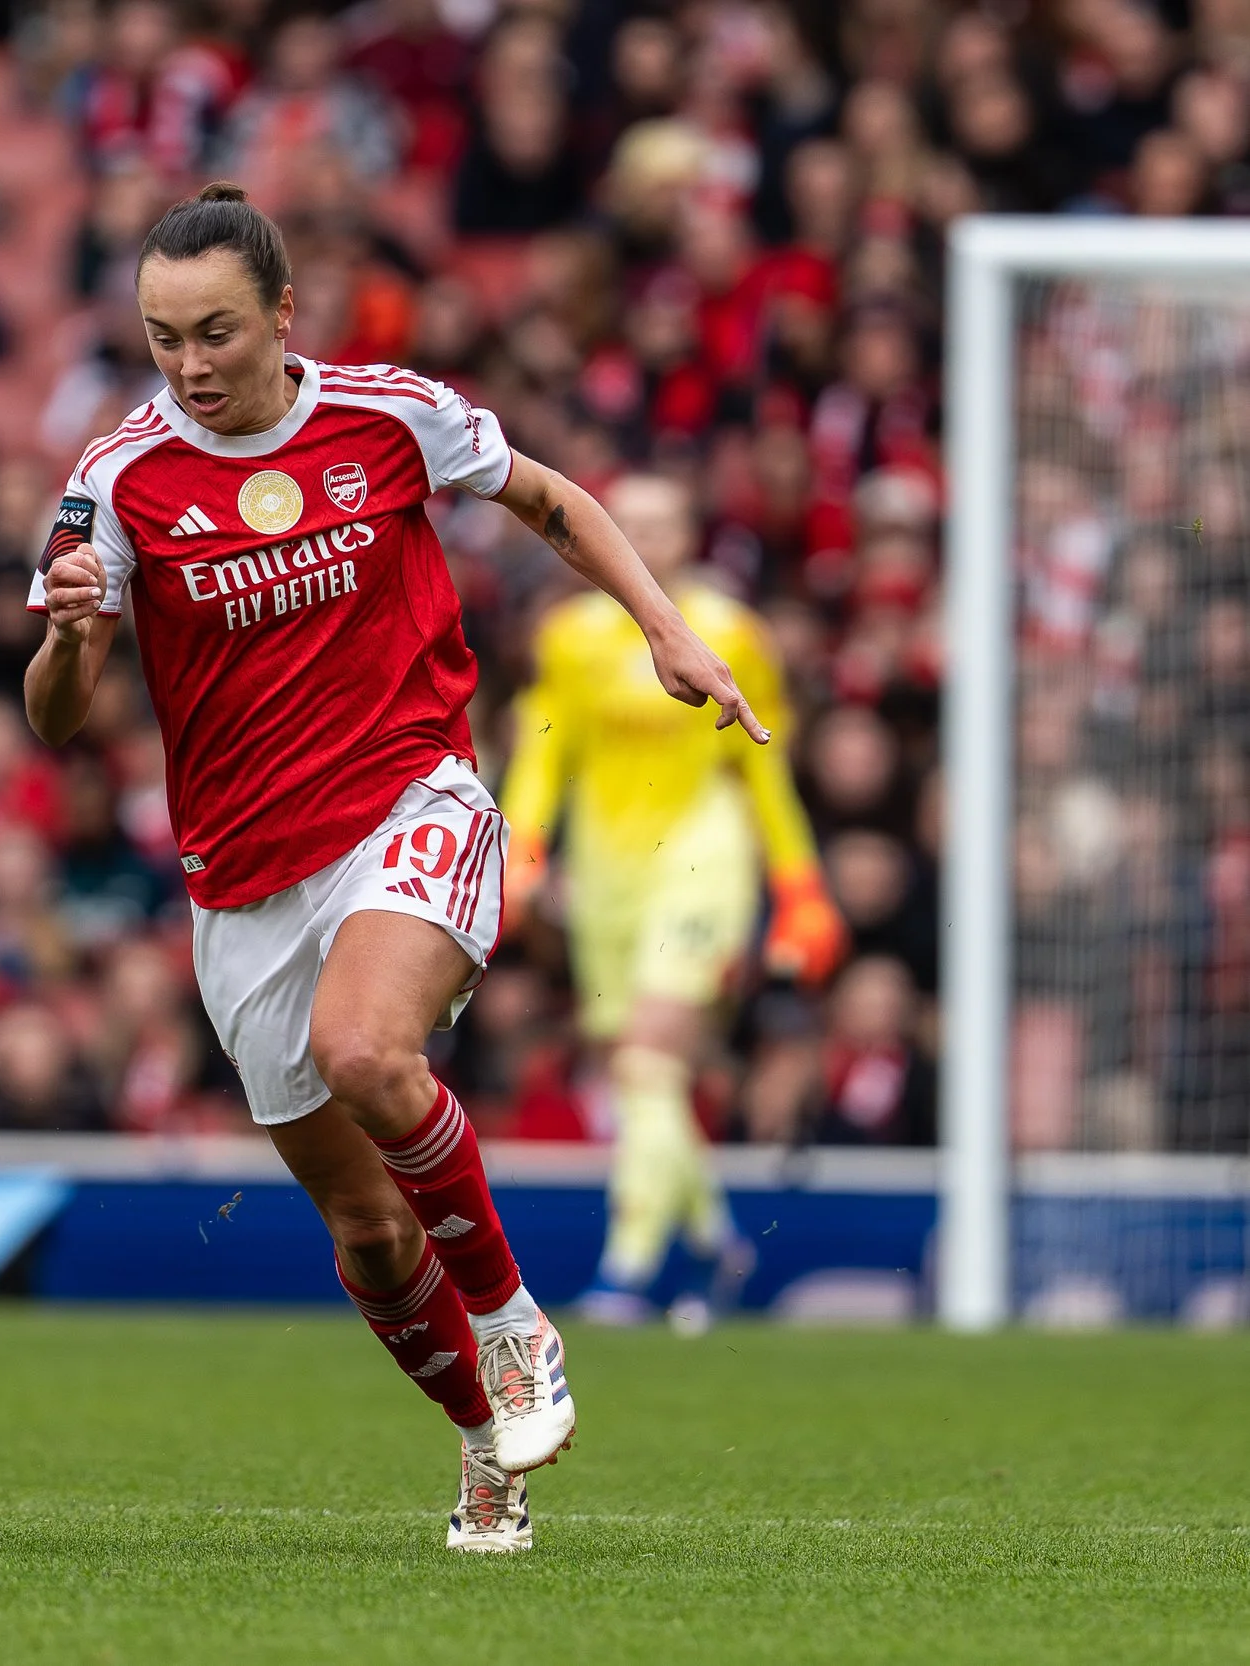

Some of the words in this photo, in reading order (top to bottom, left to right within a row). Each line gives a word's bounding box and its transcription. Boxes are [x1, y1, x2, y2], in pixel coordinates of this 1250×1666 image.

[330, 470, 360, 483] Arsenal
[180, 522, 375, 602] Emirates
[224, 591, 262, 630] FLY
[272, 560, 358, 616] BETTER
[382, 823, 457, 879] 19
